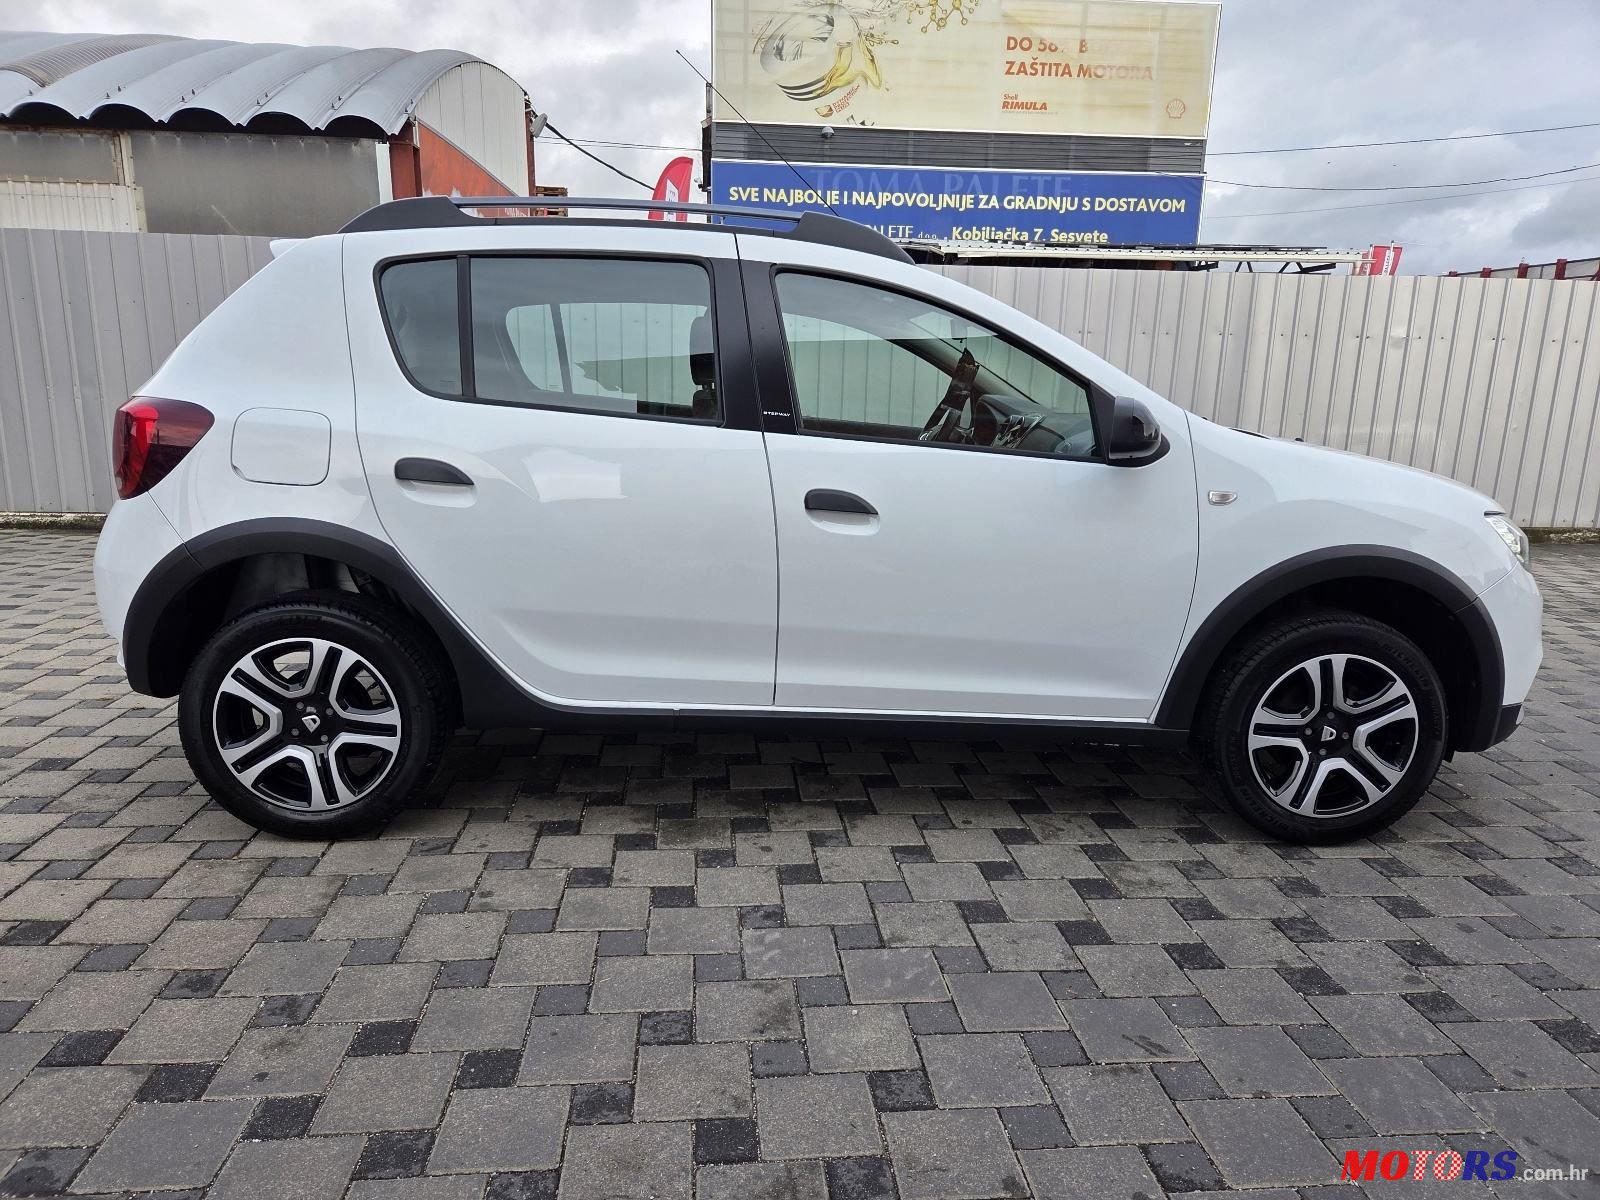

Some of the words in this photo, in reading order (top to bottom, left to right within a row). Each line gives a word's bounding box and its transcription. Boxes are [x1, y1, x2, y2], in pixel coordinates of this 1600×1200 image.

[1006, 36, 1033, 52] DO
[1005, 56, 1072, 78] ZAŠTITA
[1077, 64, 1153, 80] MOTORA
[1001, 100, 1048, 110] RIMULA
[729, 186, 759, 201] SVE
[764, 188, 840, 207] NAJBOLJE
[843, 191, 848, 205] I
[852, 191, 974, 211] NAJPOVOLJNIJE
[978, 194, 999, 209] ZA
[1003, 196, 1078, 214] GRADNJU
[1082, 197, 1091, 210] S
[1095, 198, 1185, 213] DOSTAVOM
[1050, 228, 1108, 242] Sesvete
